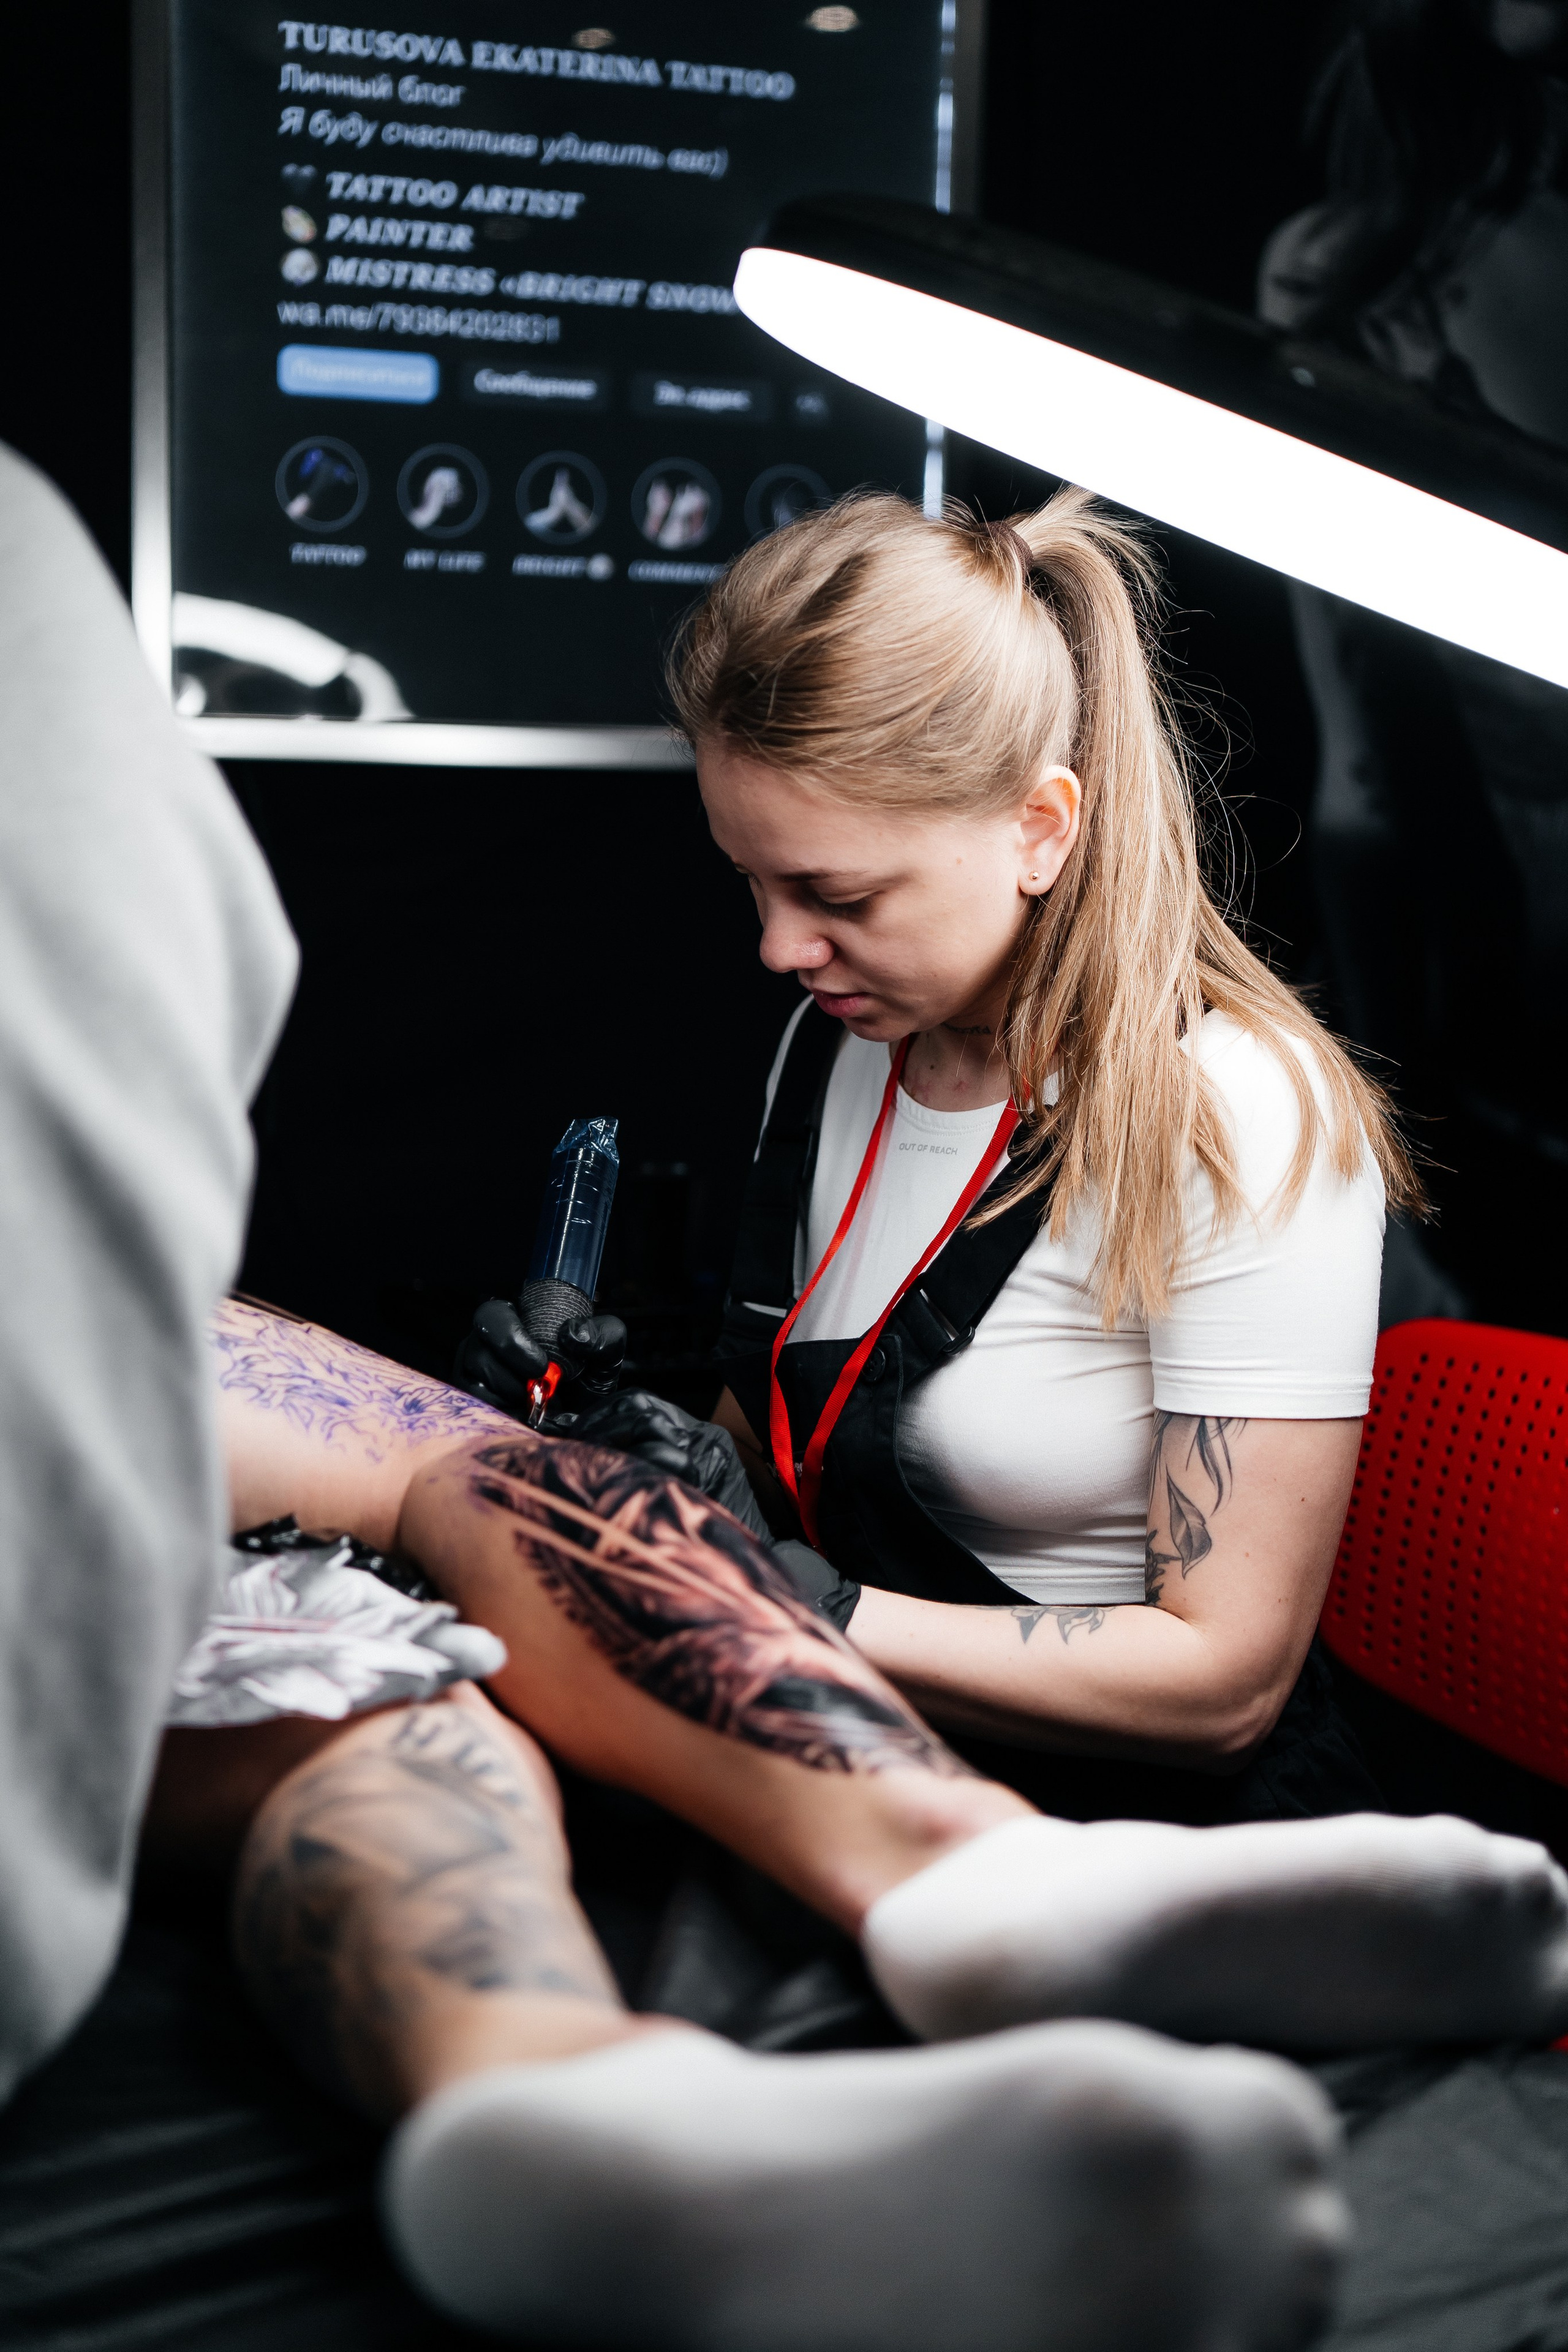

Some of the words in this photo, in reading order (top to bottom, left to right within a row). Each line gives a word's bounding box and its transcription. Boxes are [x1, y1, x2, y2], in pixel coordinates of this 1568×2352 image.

[277, 20, 467, 66] TURUSOVA
[471, 40, 663, 88] EKATERINA
[665, 60, 796, 101] TATTOO
[278, 62, 394, 100] Личный
[397, 74, 467, 108] блог
[277, 105, 306, 136] Я
[308, 108, 380, 149] буду
[381, 121, 539, 158] счастлива
[540, 132, 666, 170] удивить
[325, 171, 459, 209] TATTOO
[460, 183, 586, 221] ARTIST
[324, 213, 475, 252] PAINTER
[325, 255, 497, 296] MISTRESS
[929, 1145, 958, 1155] REACH
